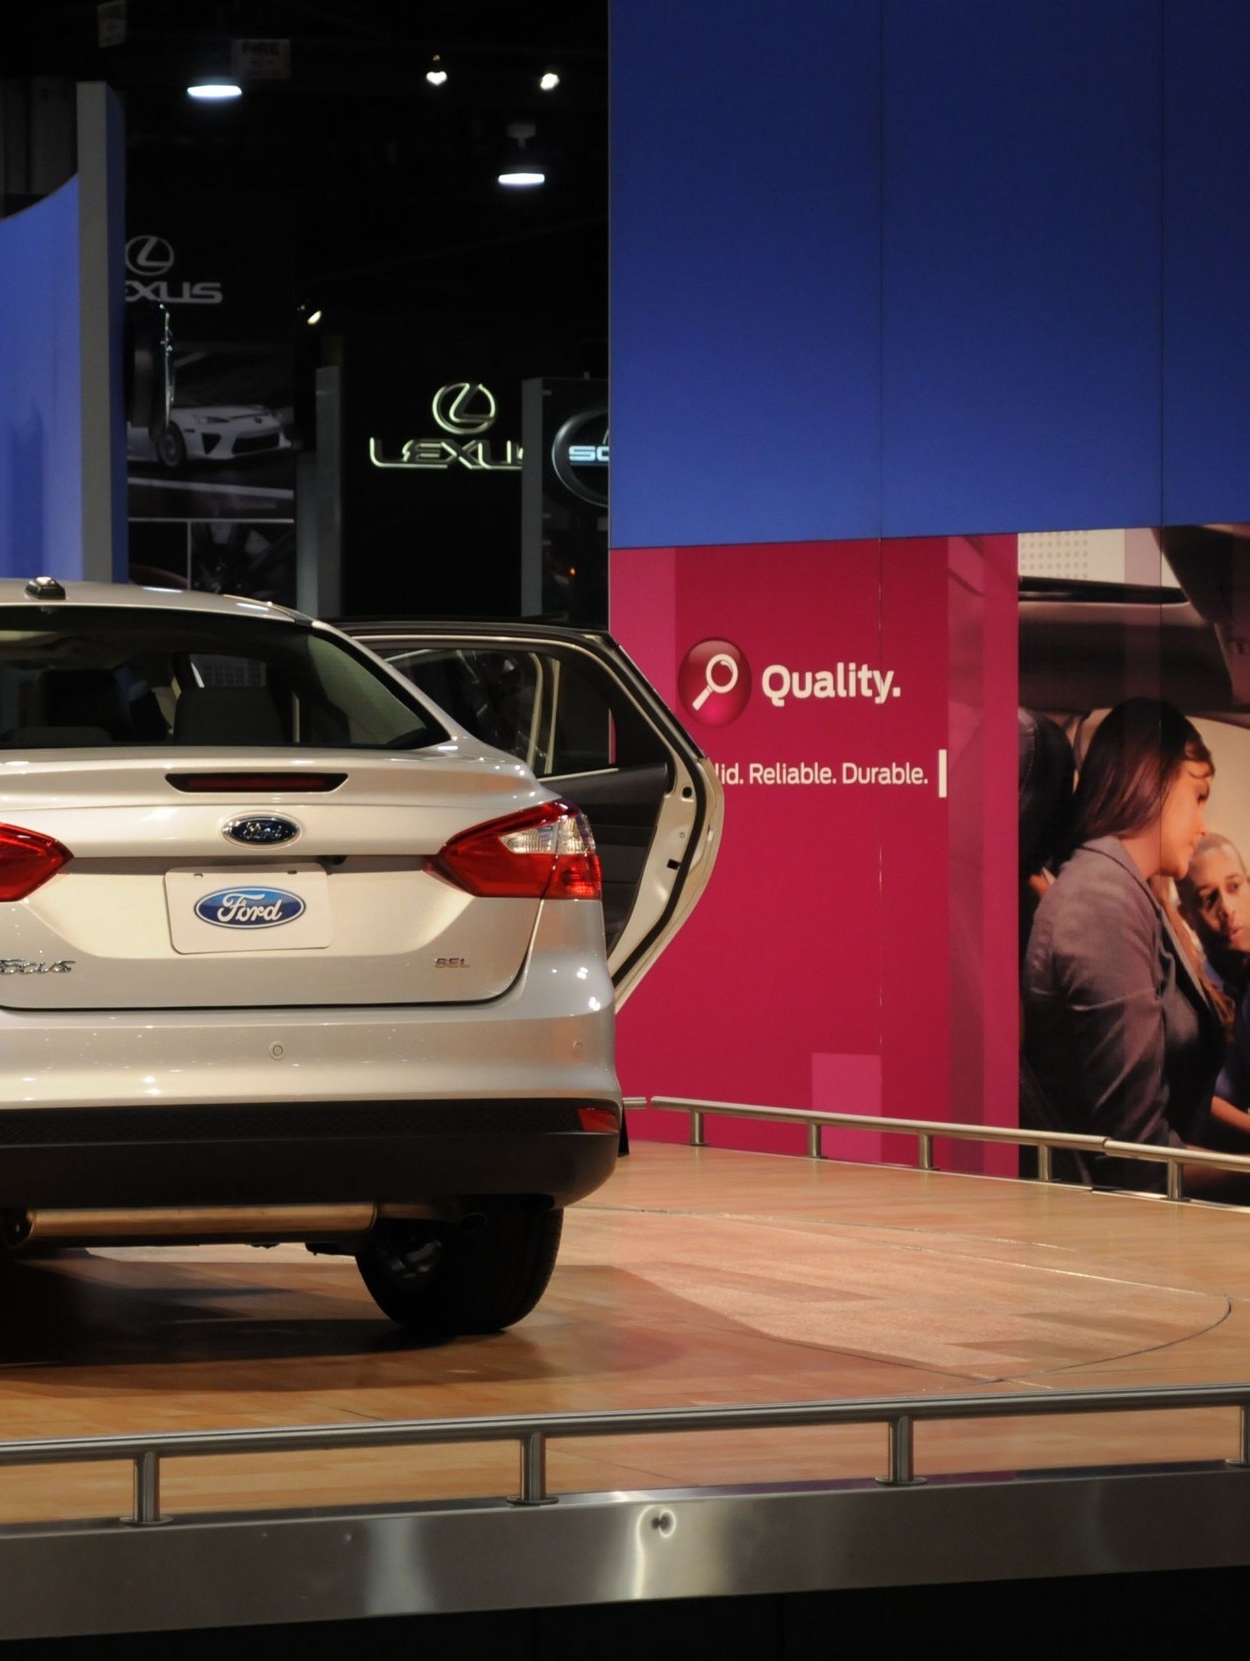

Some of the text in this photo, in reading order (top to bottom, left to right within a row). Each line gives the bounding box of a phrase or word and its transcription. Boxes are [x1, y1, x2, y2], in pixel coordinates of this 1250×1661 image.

[369, 437, 523, 469] LEXU
[762, 662, 901, 707] Quality.
[749, 762, 837, 785] Reliable.
[842, 762, 929, 785] Durable.
[217, 892, 283, 922] Ford
